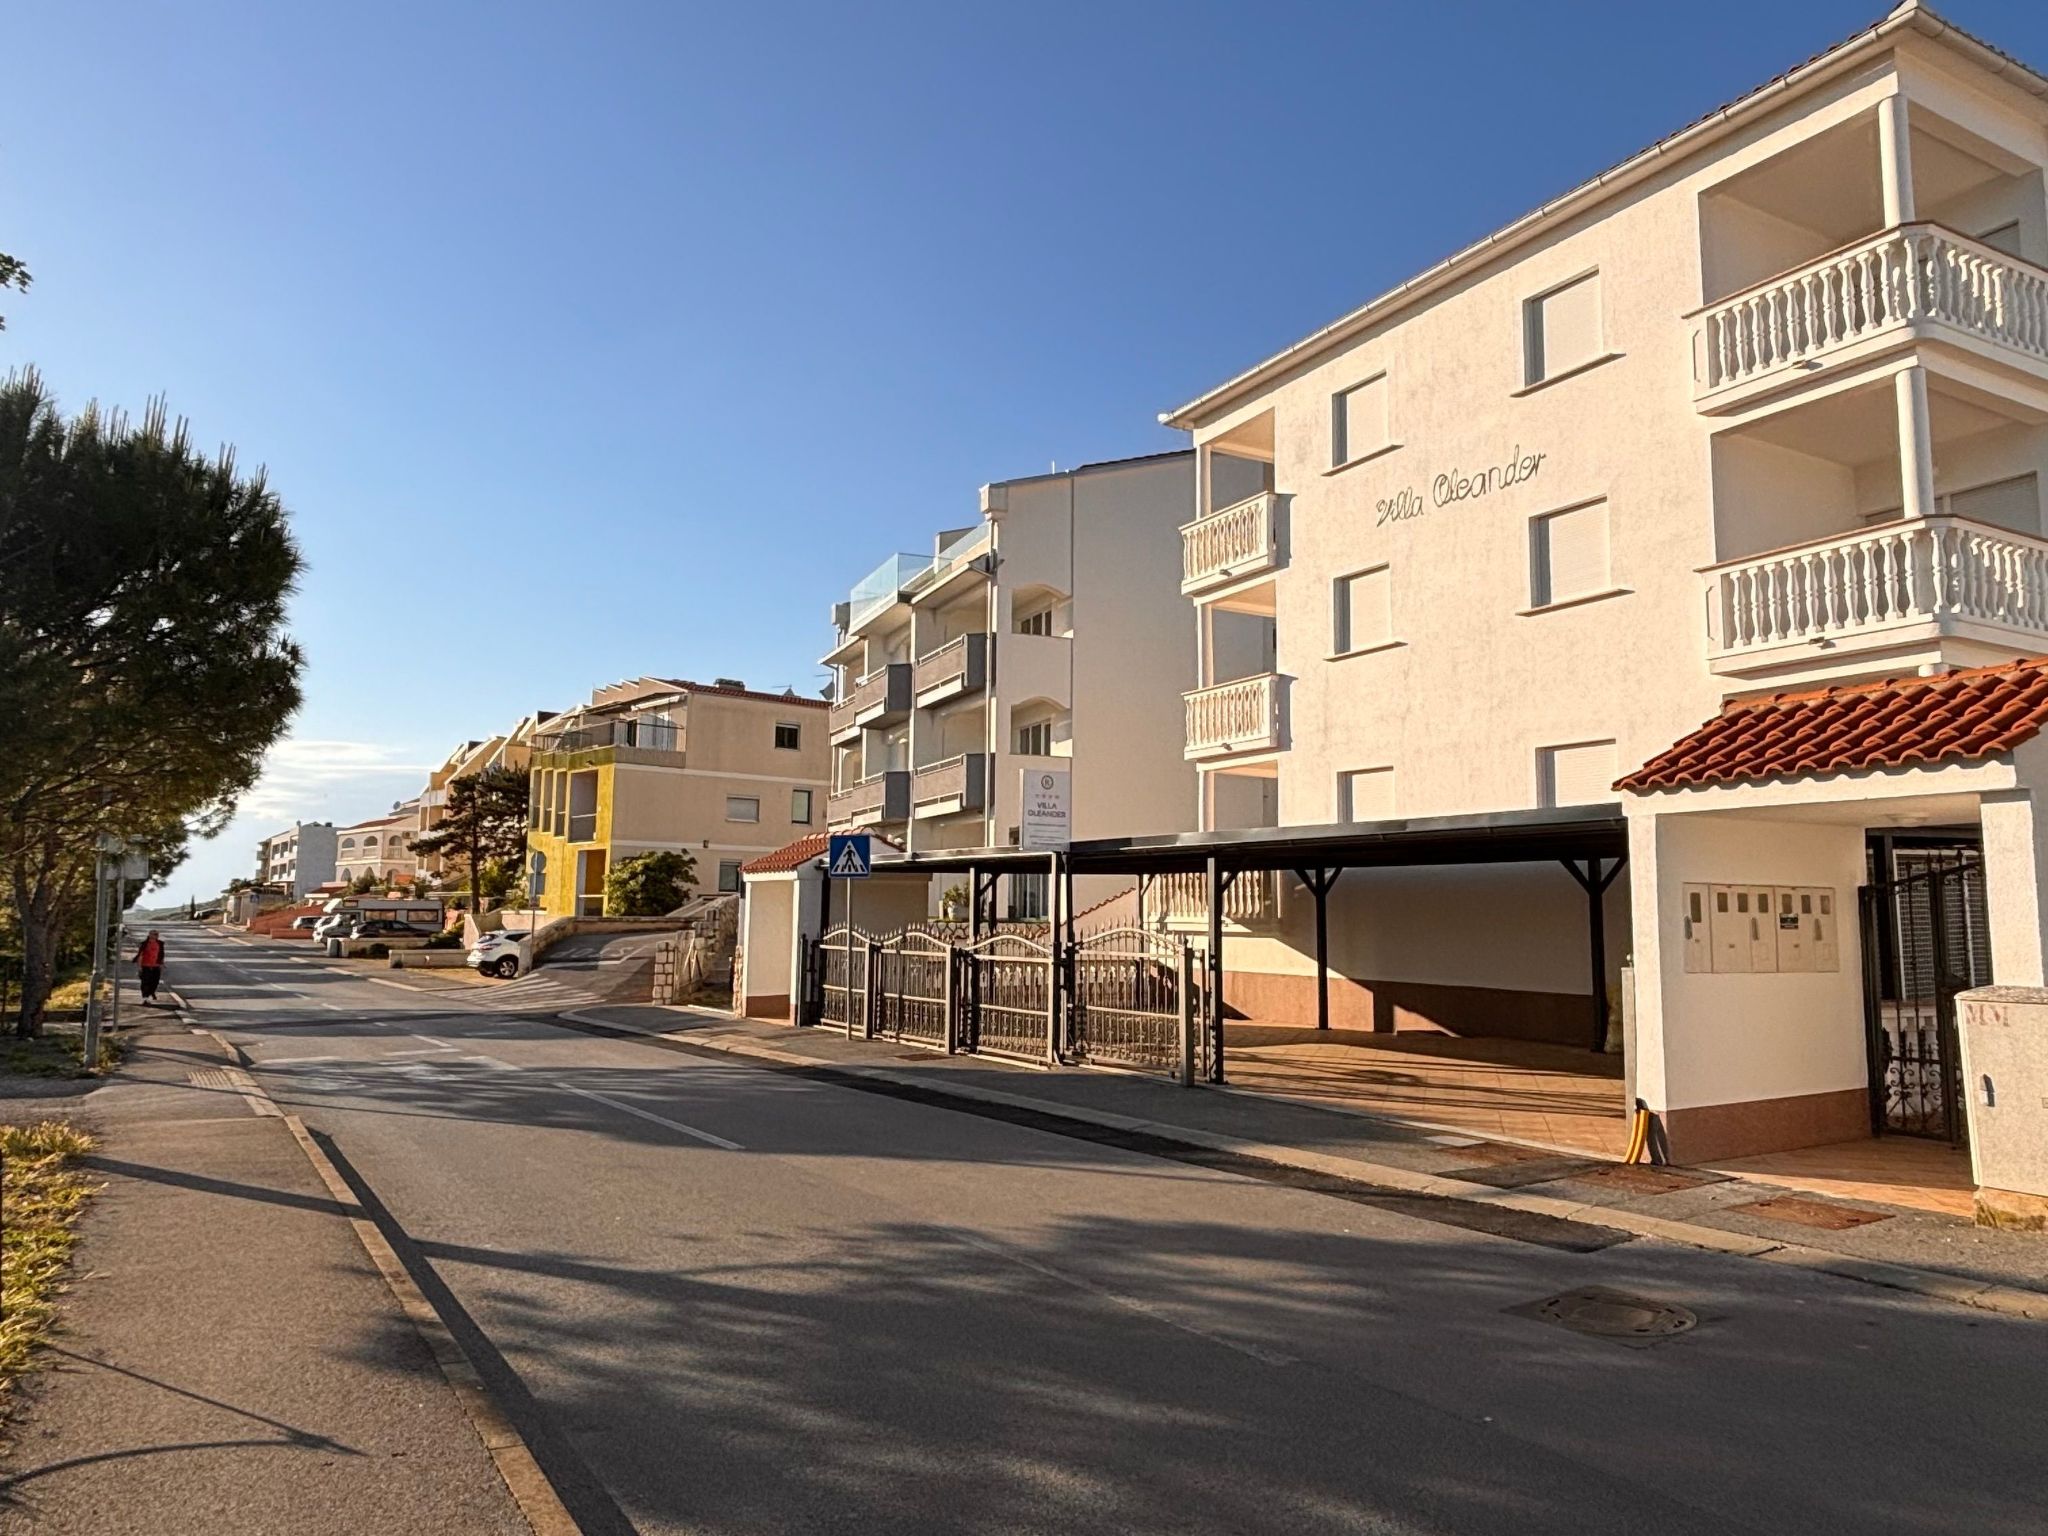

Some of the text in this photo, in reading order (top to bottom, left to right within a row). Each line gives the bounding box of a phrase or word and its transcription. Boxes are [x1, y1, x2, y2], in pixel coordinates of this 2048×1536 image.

[1376, 444, 1547, 528] Villa Oleander
[1036, 801, 1057, 810] VILLA
[1027, 809, 1067, 818] OLEANDER
